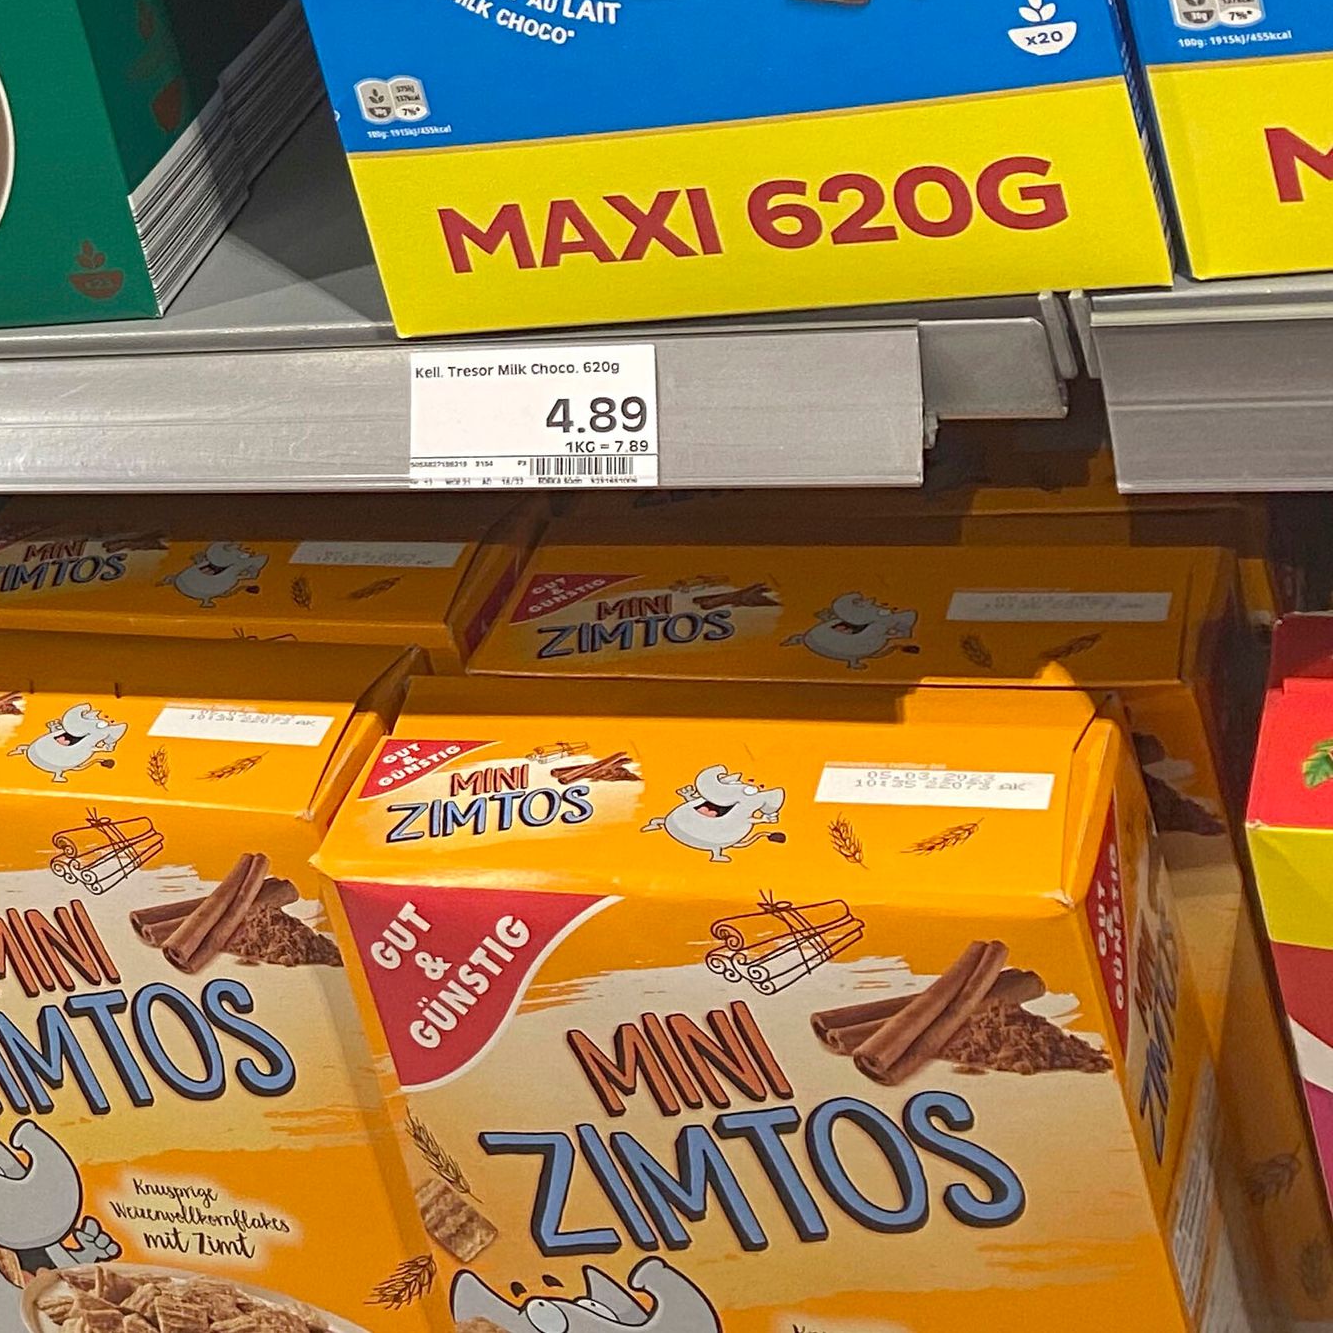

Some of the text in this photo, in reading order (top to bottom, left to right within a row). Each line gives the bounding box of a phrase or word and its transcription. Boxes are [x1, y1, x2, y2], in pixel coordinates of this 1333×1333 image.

[1026, 30, 1063, 44] x20
[438, 156, 1068, 274] MAXI 620G
[415, 361, 620, 379] Kell. Tresor Milk Choco. 620g
[546, 396, 647, 434] 4.89
[23, 540, 88, 565] MINI
[595, 593, 674, 621] MINI
[537, 610, 735, 658] ZIMTOS
[376, 743, 462, 790] GÜNSTIG
[451, 764, 530, 795] MINI
[386, 784, 593, 842] ZIMTOS
[370, 899, 425, 971] GUT
[409, 911, 532, 1050] GÜNSTIG
[424, 950, 454, 981] &
[567, 1001, 793, 1117] MINI
[480, 1090, 1026, 1257] ZIMTOS
[133, 1178, 218, 1208] Knusprige
[144, 1227, 255, 1258] mit Zimt
